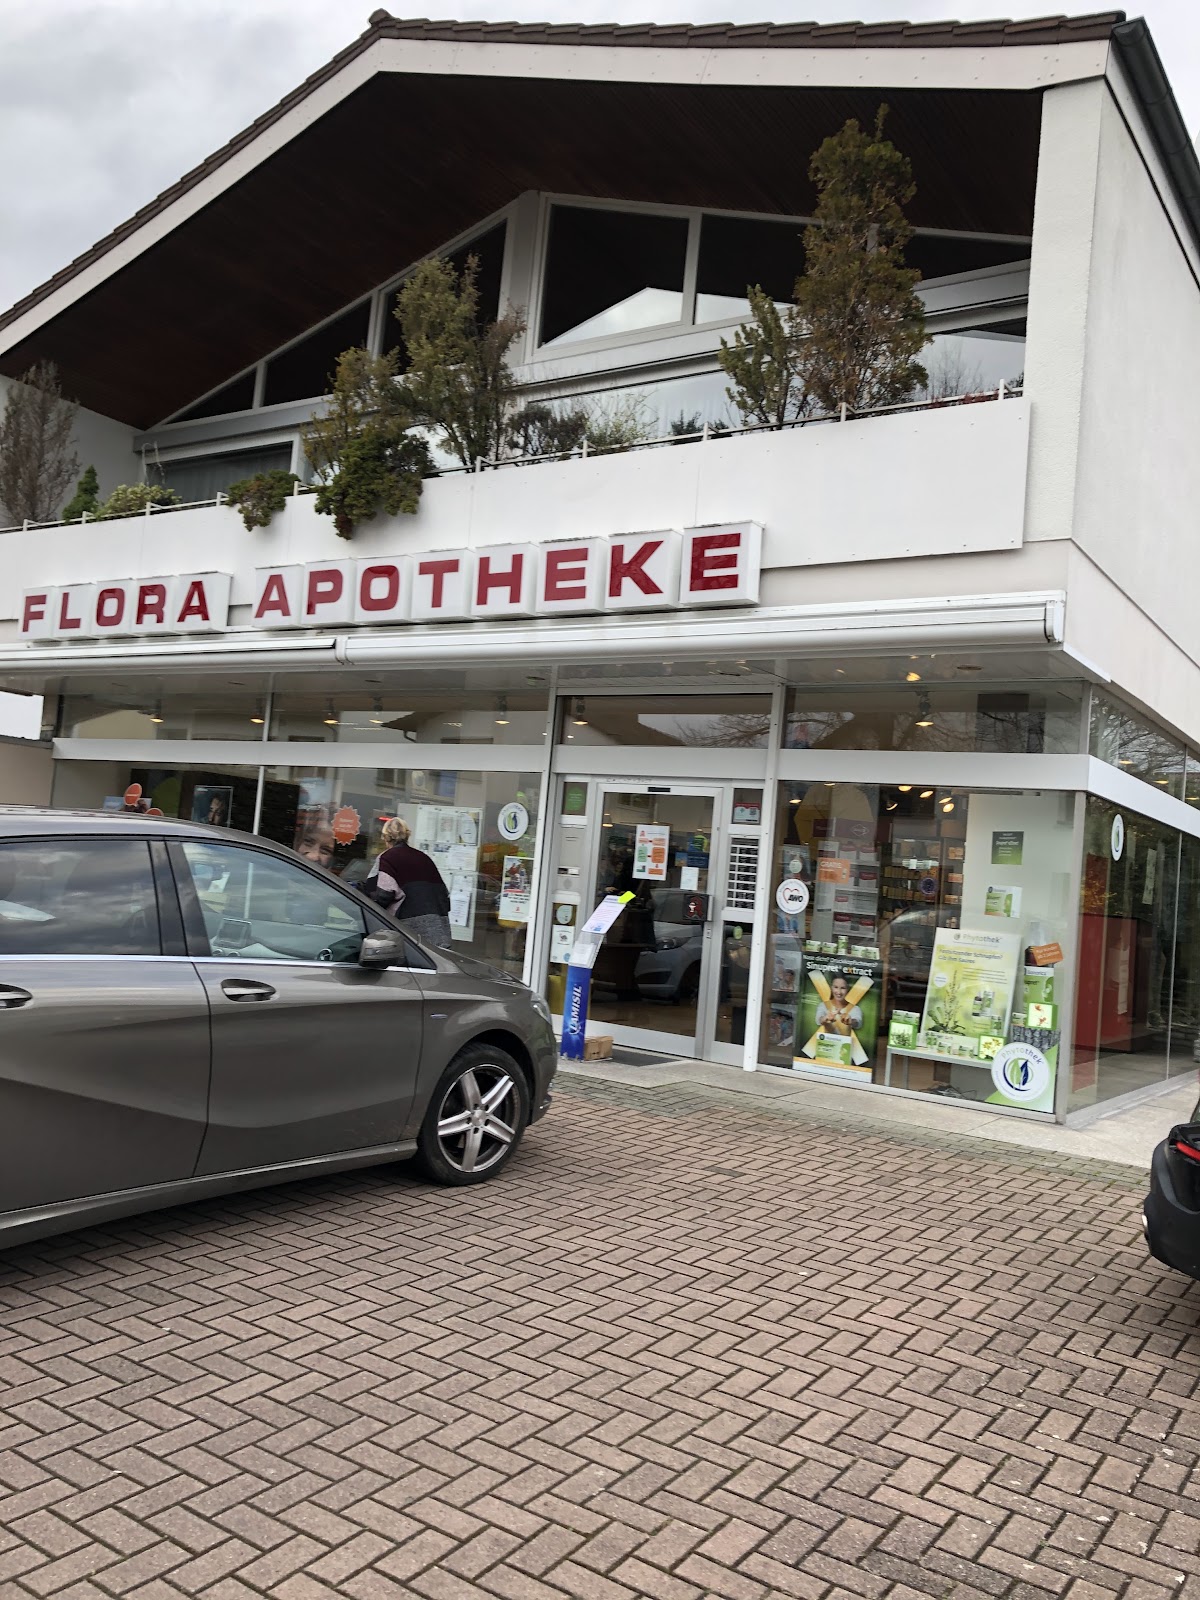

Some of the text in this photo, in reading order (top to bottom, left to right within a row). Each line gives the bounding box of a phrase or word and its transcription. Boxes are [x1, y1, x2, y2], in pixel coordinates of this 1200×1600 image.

[22, 532, 742, 633] FLORA APOTHEKE
[788, 894, 804, 903] AWO
[842, 966, 873, 976] extract
[569, 985, 583, 1035] LAMISIL
